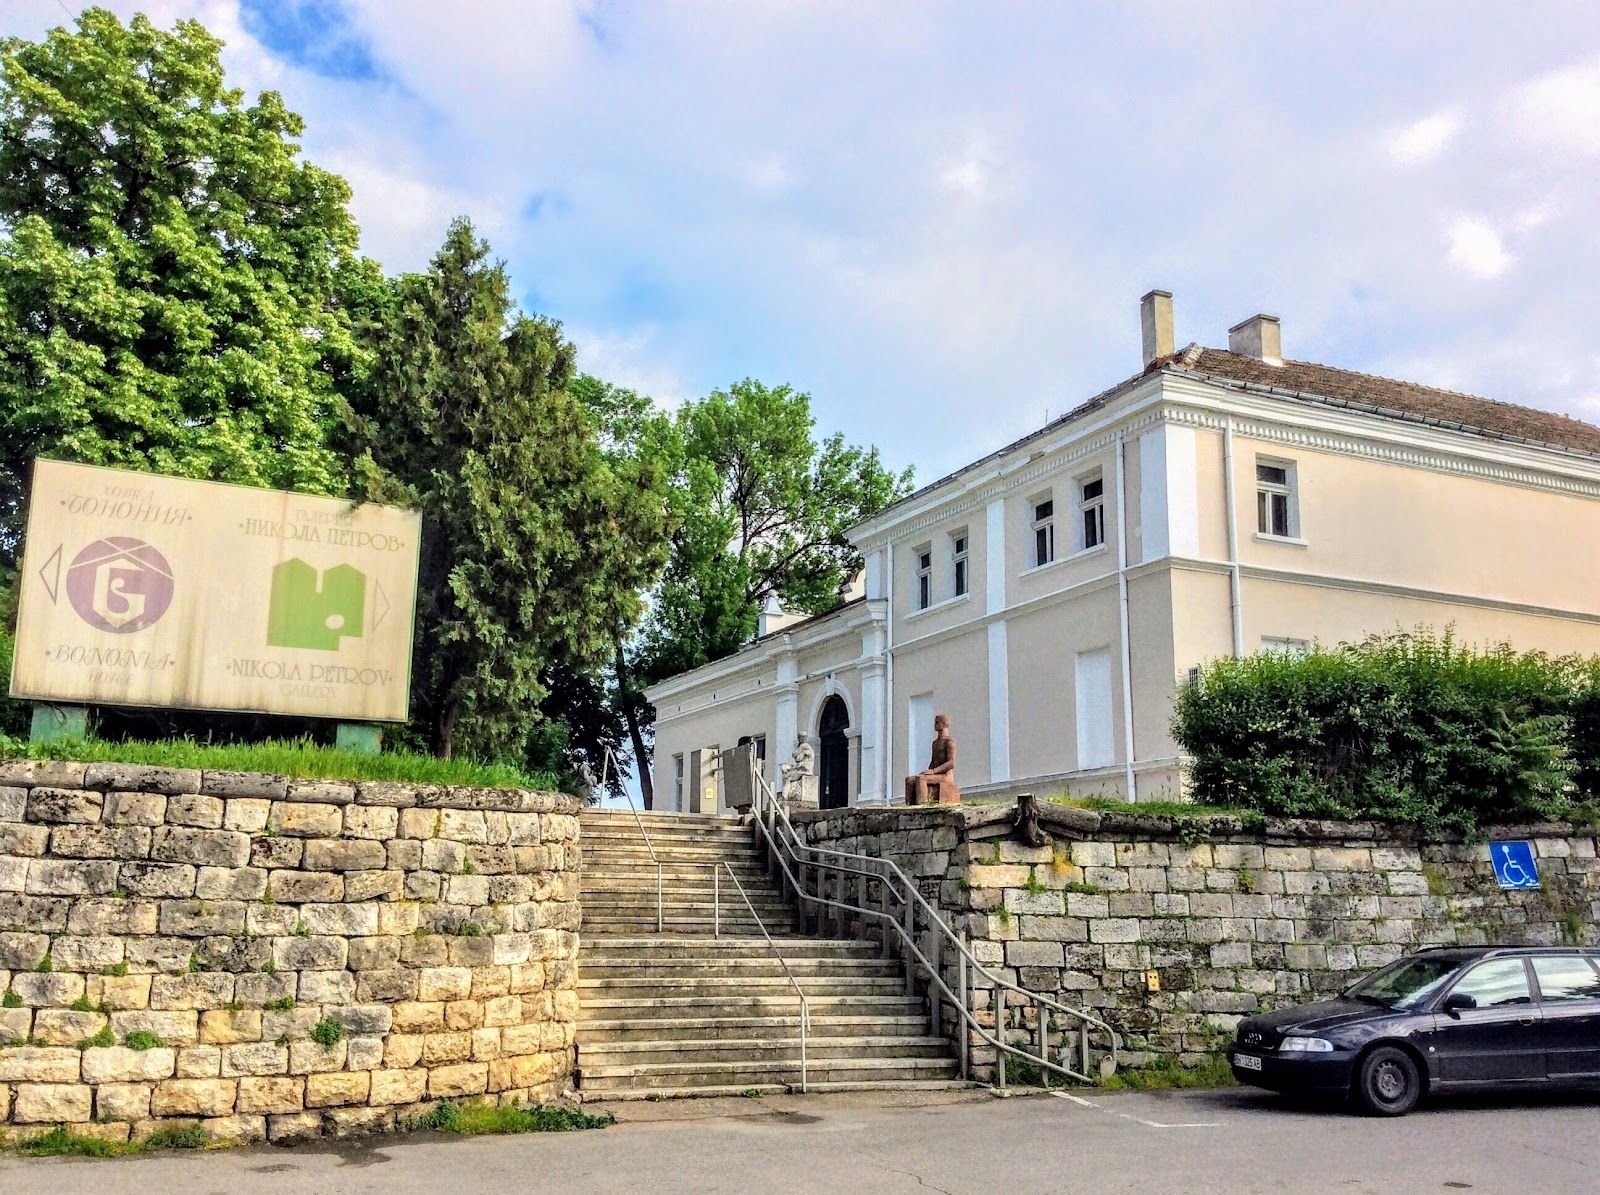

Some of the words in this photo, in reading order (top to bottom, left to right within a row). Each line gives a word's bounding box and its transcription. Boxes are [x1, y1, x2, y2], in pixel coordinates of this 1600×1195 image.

[68, 493, 189, 527] БОНОНИЯ
[245, 517, 321, 542] НИКОЛА
[327, 527, 401, 552] ПЕТРОВ
[49, 644, 169, 670] BONONIA
[231, 657, 303, 681] NIKOLA
[309, 663, 390, 687] PETROV
[280, 683, 336, 699] GALLERY
